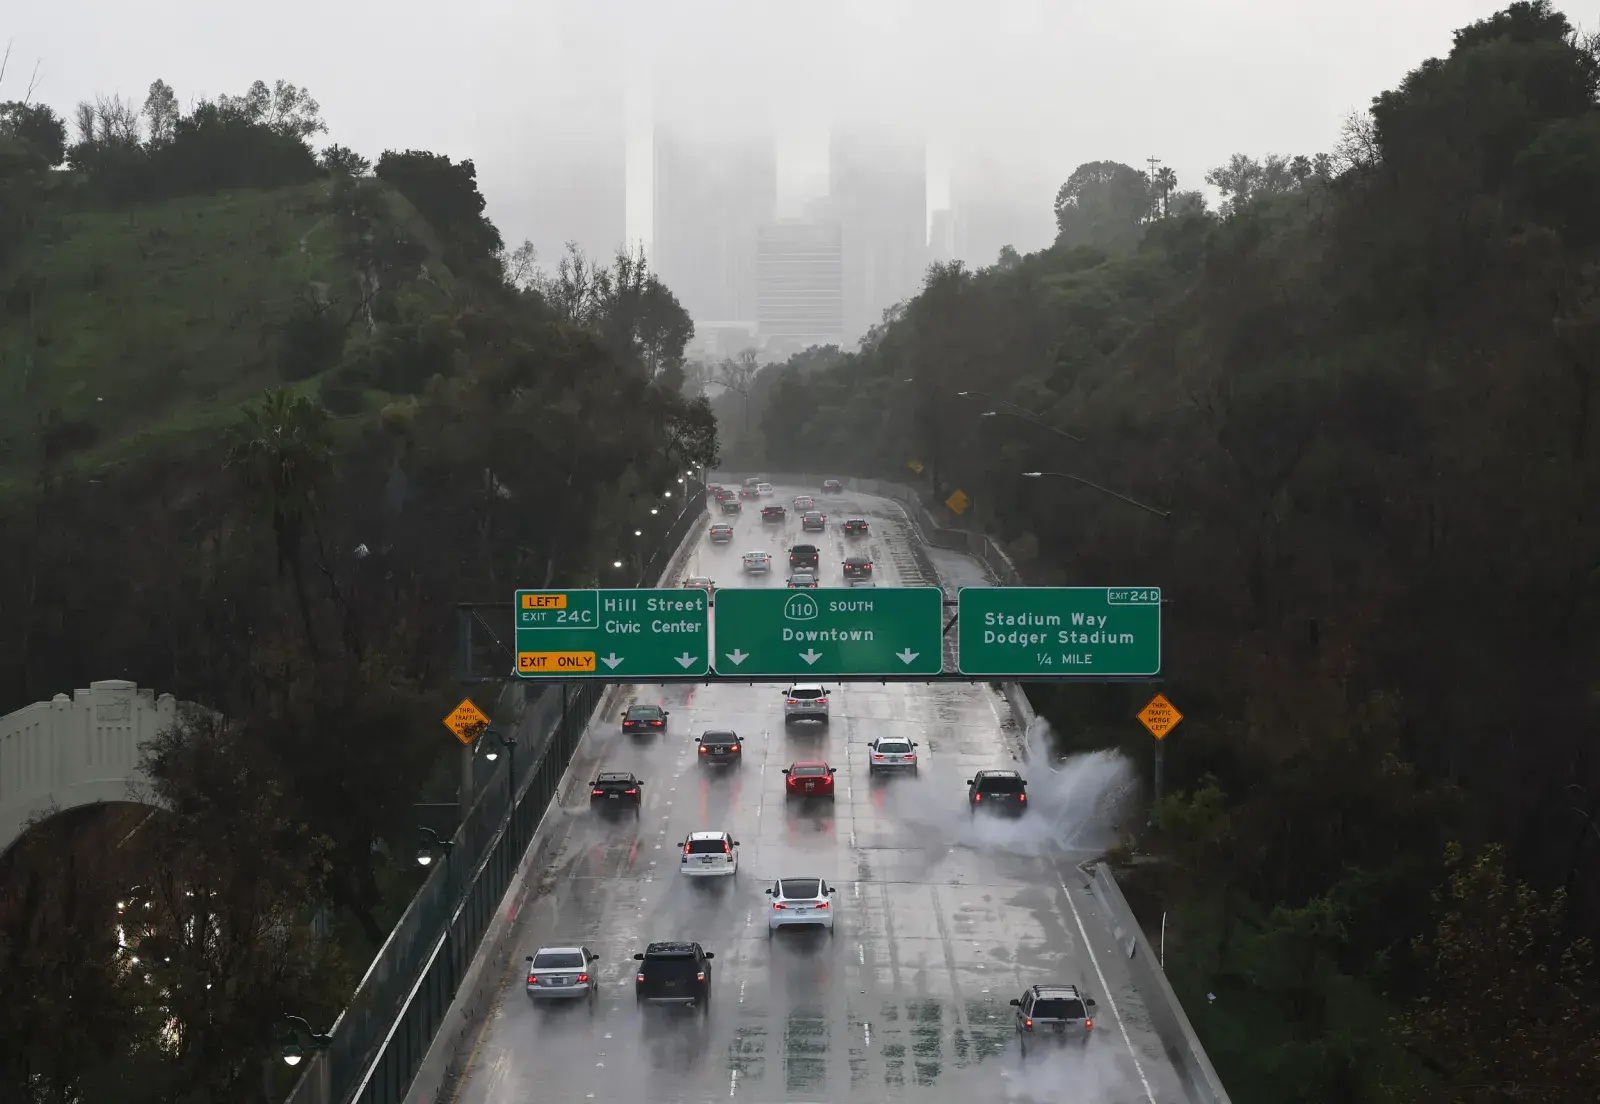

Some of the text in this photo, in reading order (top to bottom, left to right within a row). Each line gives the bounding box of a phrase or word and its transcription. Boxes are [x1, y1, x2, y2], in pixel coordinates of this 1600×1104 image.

[529, 597, 560, 607] LEFT
[1109, 592, 1129, 600] EXIT
[604, 598, 703, 612] Hill Street
[790, 603, 813, 616] 110
[829, 601, 874, 612] SOUTH
[522, 610, 591, 623] EXIT 24C
[984, 612, 1107, 628] Stadium Way
[605, 619, 702, 634] Civic Center
[782, 628, 874, 641] Downtown
[984, 630, 1134, 648] Dodger Stadium
[520, 656, 593, 668] EXIT ONLY
[1062, 654, 1093, 664] MILE
